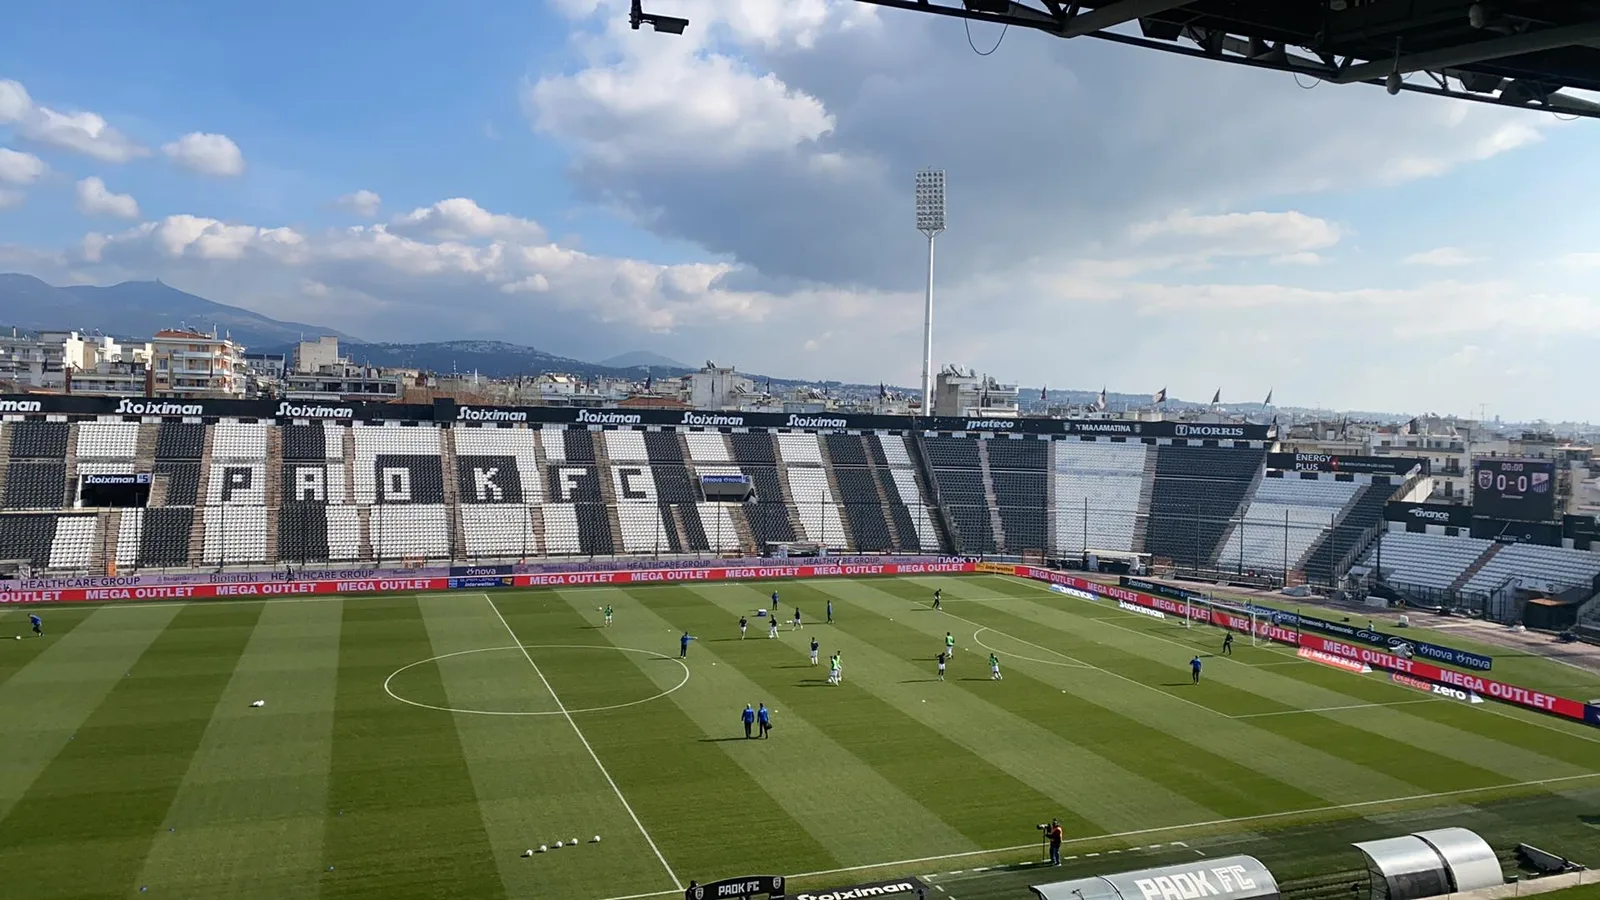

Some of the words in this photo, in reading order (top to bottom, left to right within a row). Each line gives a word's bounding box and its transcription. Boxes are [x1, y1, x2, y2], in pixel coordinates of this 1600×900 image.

[275, 402, 353, 419] Stoiximan
[457, 407, 527, 422] Stoiximan
[576, 409, 641, 425] Stoiximan
[681, 411, 744, 427] Stoiximan
[786, 414, 847, 429] Stoiximan
[1188, 426, 1243, 436] MORRIS
[1296, 454, 1332, 462] ENERGY
[1296, 463, 1318, 471] PLUS
[1502, 463, 1524, 471] 00:00
[85, 474, 135, 484] Stoiximan
[682, 560, 711, 568] GROUP
[814, 566, 842, 575] MEGA
[846, 565, 884, 574] OUTLET
[897, 565, 924, 573] MEGA
[929, 564, 964, 572] OUTLET
[340, 570, 375, 579] GROUP
[530, 576, 564, 585] MEGA
[568, 574, 614, 584] OUTLET
[631, 572, 664, 581] MEGA
[667, 571, 710, 580] OUTLET
[725, 569, 756, 578] MEGA
[759, 568, 799, 577] OUTLET
[1029, 569, 1049, 581] MEGA
[1051, 573, 1075, 586] OUTLET
[21, 578, 96, 589] HEALTHCARE
[106, 577, 141, 587] GROUP
[216, 585, 257, 595] MEGA
[262, 583, 317, 593] OUTLET
[337, 582, 376, 591] MEGA
[380, 580, 431, 590] OUTLET
[0, 591, 62, 602] OUTLET
[86, 589, 130, 600] MEGA
[135, 587, 194, 598] OUTLET
[1087, 582, 1108, 595] MEGA
[1109, 587, 1138, 602] OUTLET
[1119, 600, 1165, 619] Stoiximan
[1152, 598, 1176, 612] MEGA
[1311, 650, 1362, 670] MORRIS
[1323, 640, 1358, 658] MEGA
[1362, 650, 1414, 672] OUTLET
[1429, 648, 1452, 661] nova
[1463, 656, 1490, 669] nova
[1432, 684, 1466, 700] zero
[1440, 669, 1485, 692] MEGA
[1489, 683, 1556, 709] OUTLET
[1134, 868, 1220, 900] PAOK
[1211, 864, 1257, 893] FC
[718, 883, 745, 897] PAOK
[747, 881, 760, 894] FC
